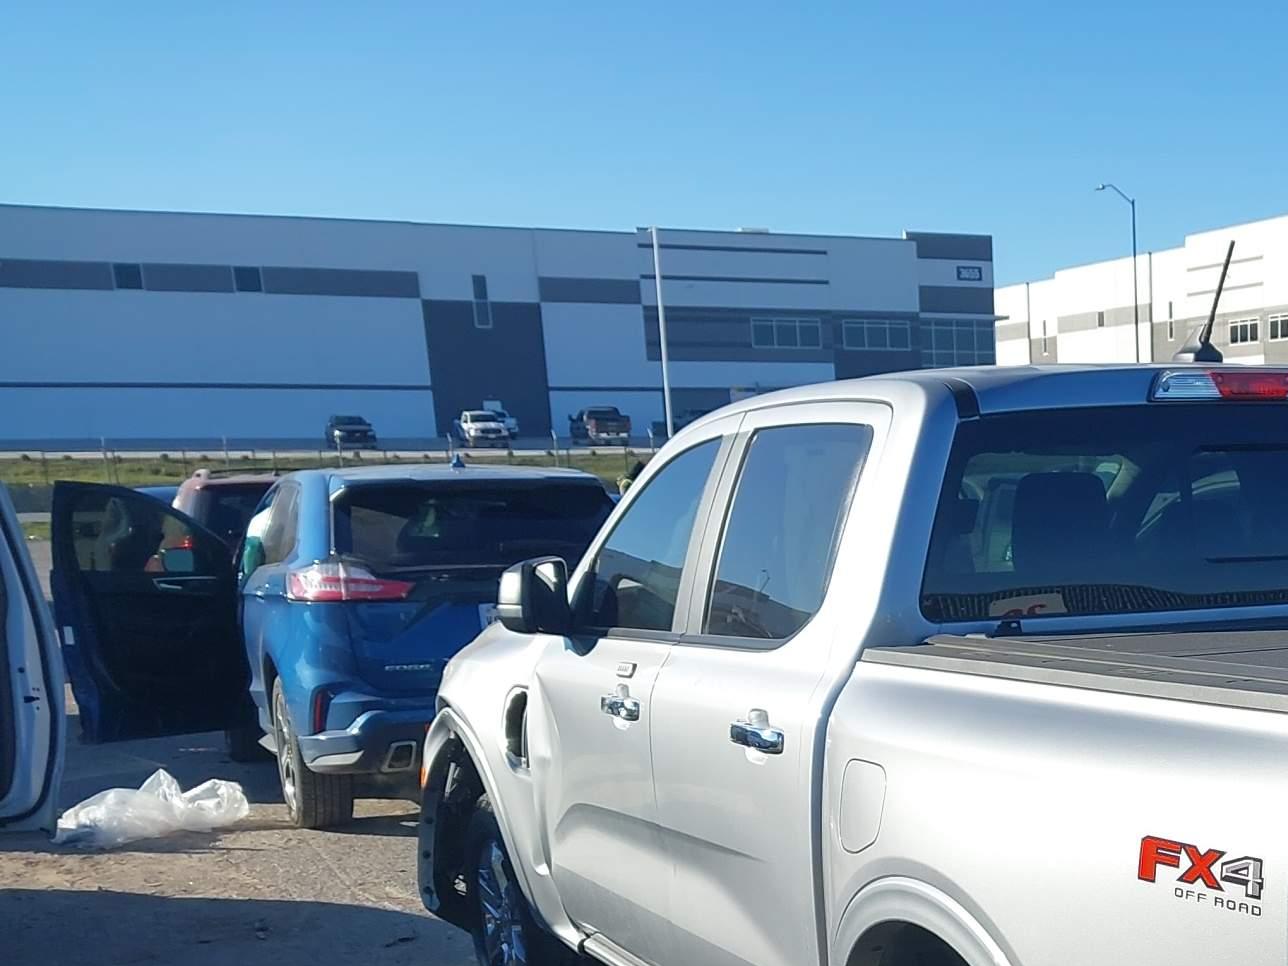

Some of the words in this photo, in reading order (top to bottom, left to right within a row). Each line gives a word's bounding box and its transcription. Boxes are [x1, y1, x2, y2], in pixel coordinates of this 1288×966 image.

[1138, 835, 1264, 900] FX4
[1174, 886, 1208, 903] OFF
[1213, 895, 1262, 917] ROAD
